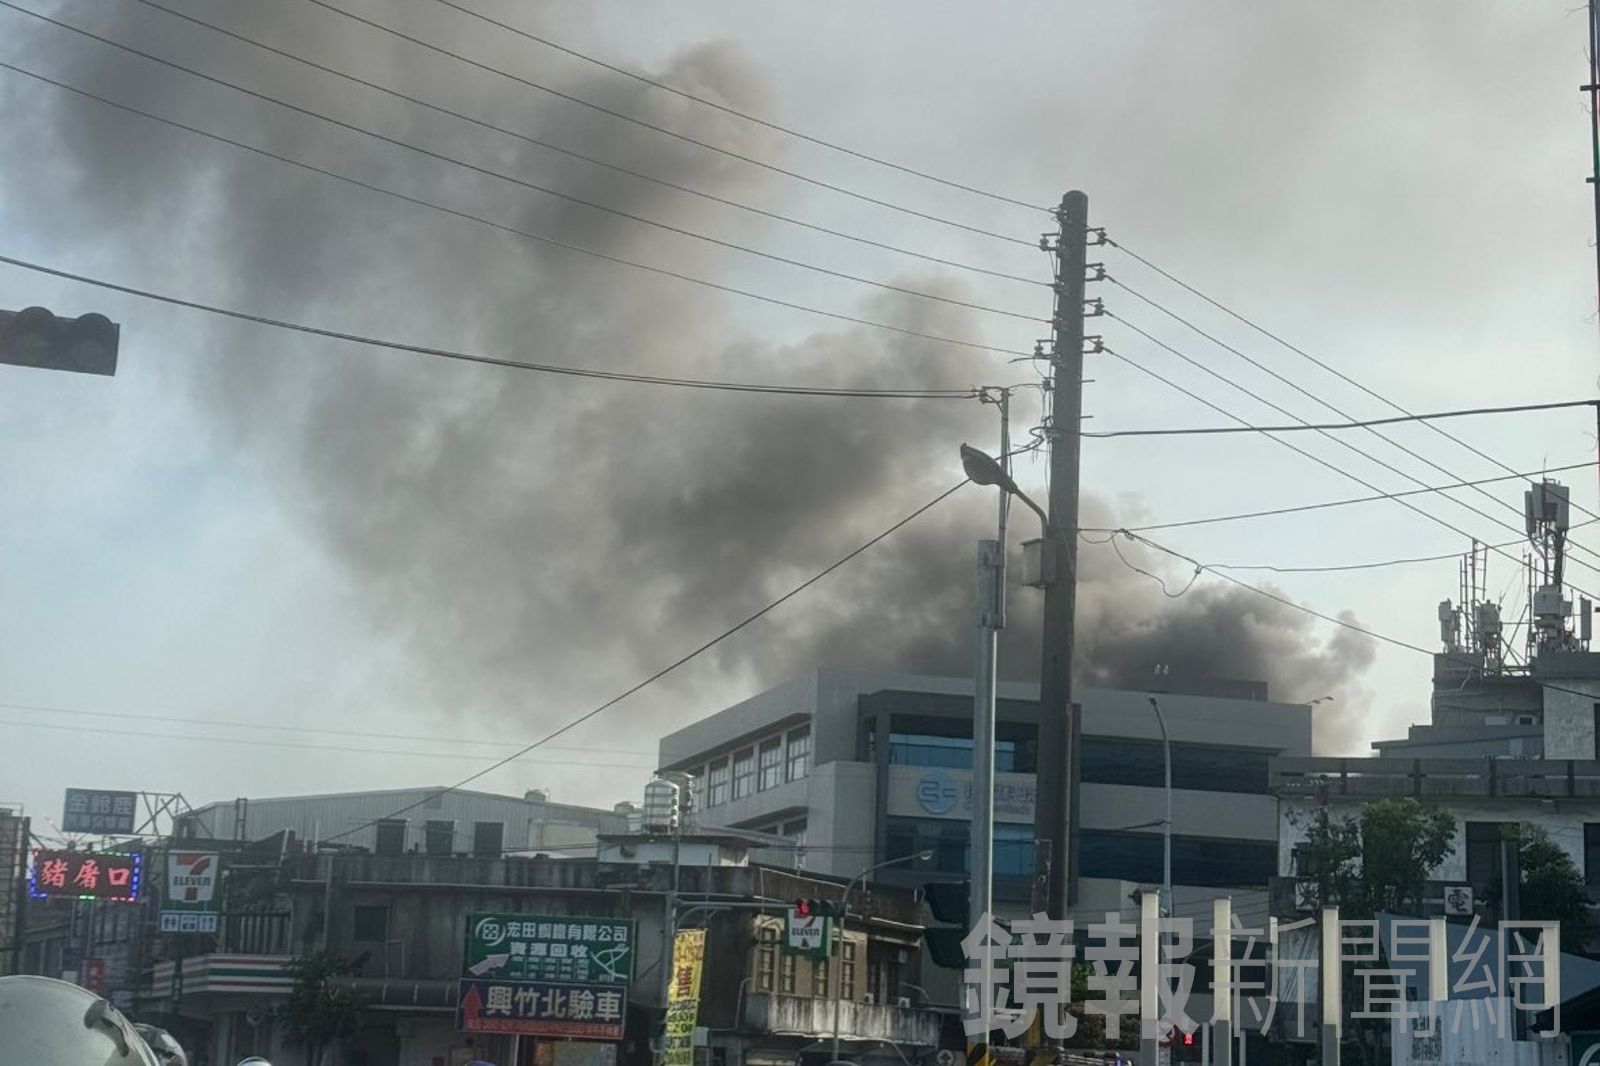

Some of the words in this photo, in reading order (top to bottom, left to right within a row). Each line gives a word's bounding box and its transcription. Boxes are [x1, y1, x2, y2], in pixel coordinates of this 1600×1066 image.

[485, 985, 622, 1021] 興竹北驗車
